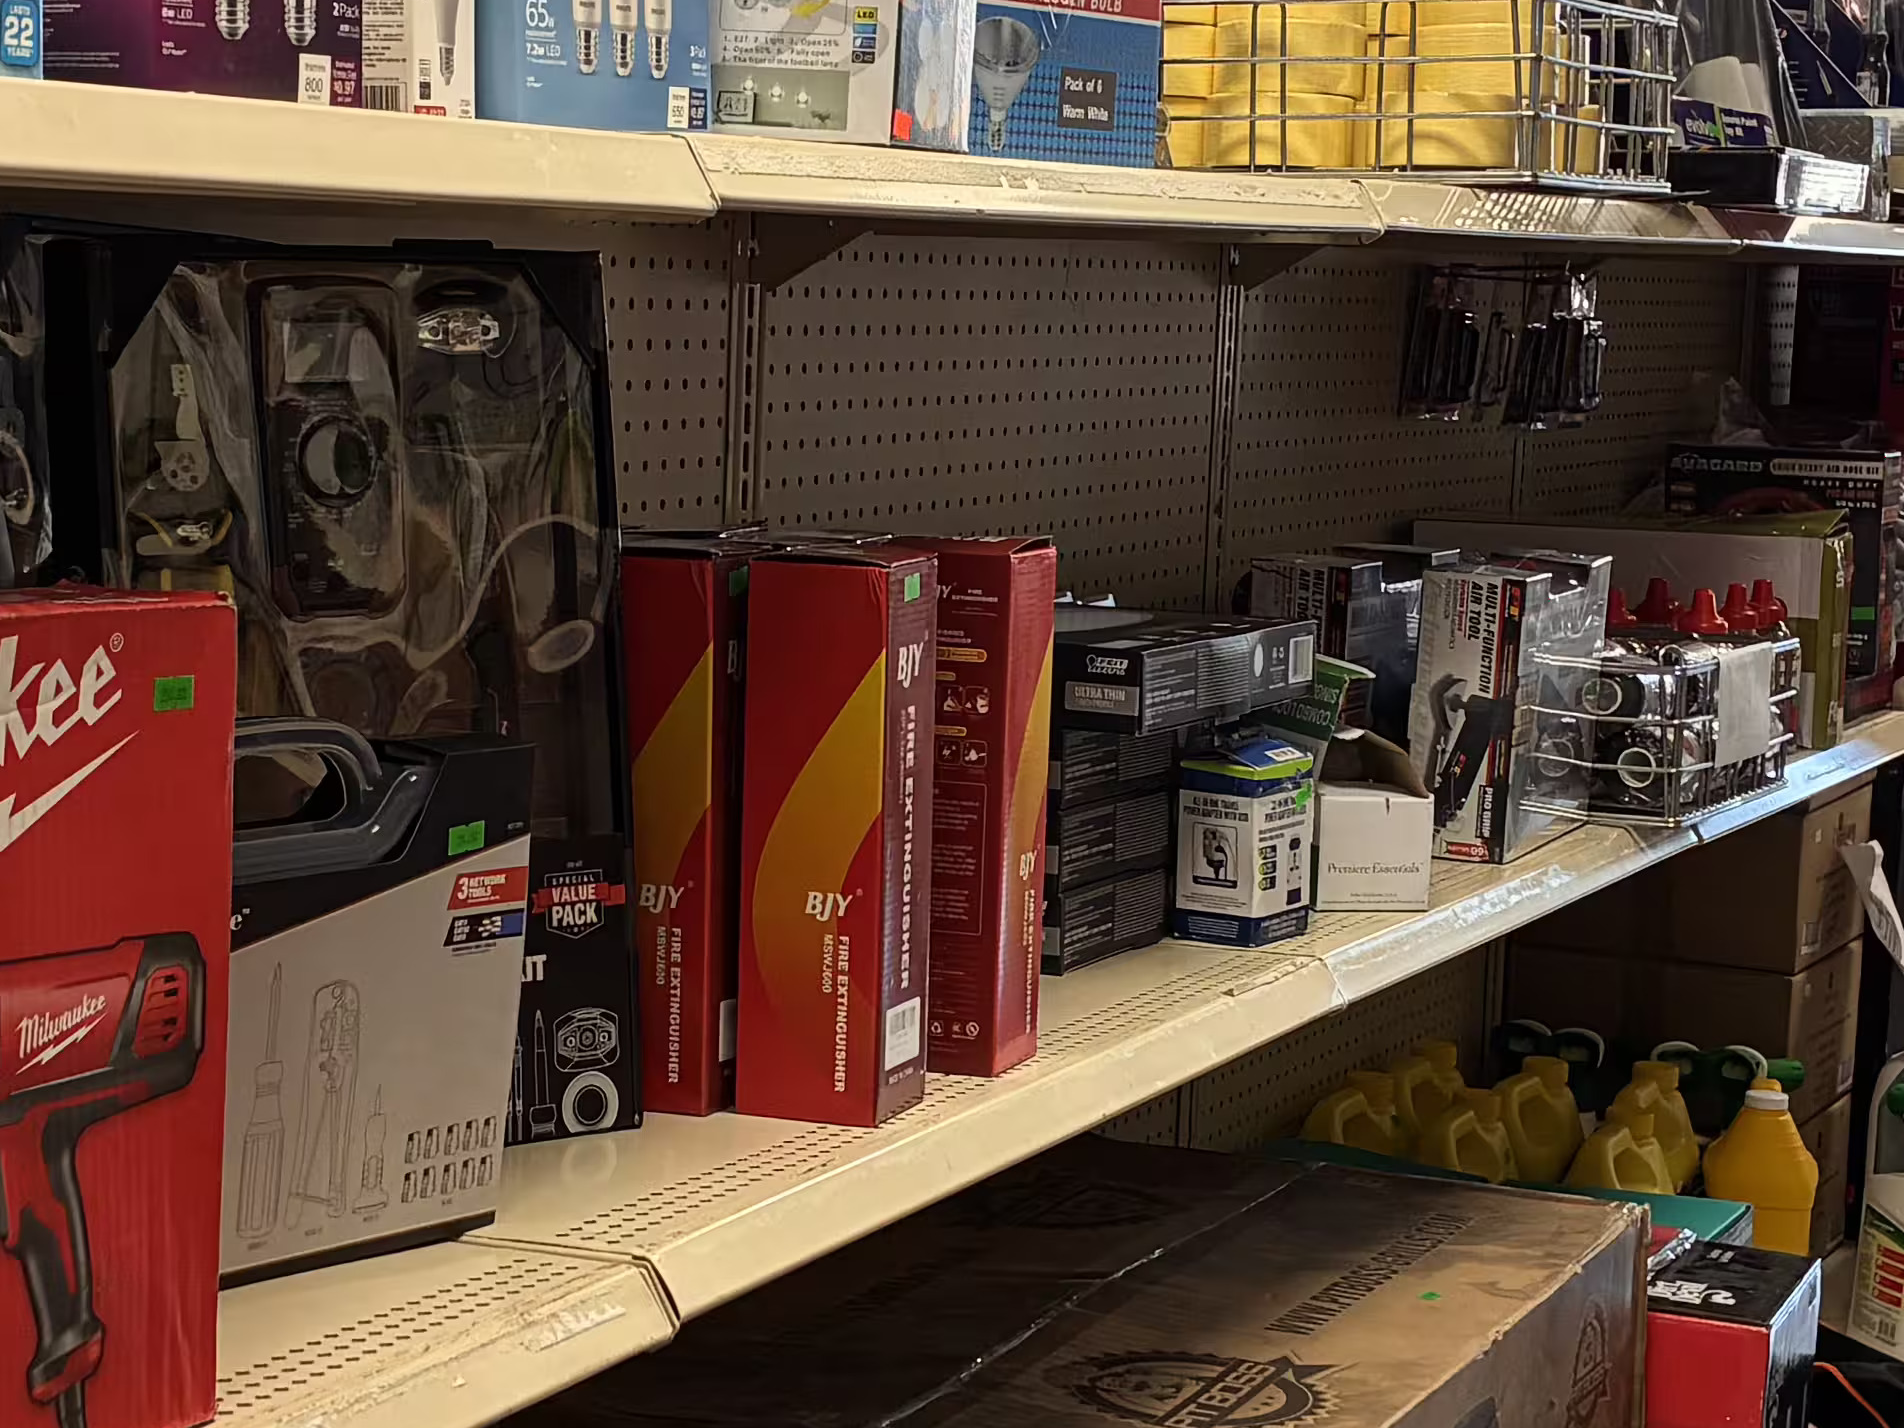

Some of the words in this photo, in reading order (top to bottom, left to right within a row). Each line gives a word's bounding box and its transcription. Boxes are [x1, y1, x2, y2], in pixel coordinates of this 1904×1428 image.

[176, 8, 194, 19] LED
[856, 9, 875, 21] LED
[2, 16, 34, 49] 22
[304, 76, 324, 94] 800
[1063, 76, 1084, 92] Pack
[1084, 79, 1095, 93] of
[1062, 104, 1085, 120] Warm
[1086, 105, 1110, 123] White
[1298, 568, 1310, 592] AIR
[1470, 580, 1485, 600] AIR
[1467, 601, 1482, 641] TOOL
[1478, 584, 1499, 695] MULTI-FUNCTION
[896, 640, 925, 689] BJY
[1073, 685, 1096, 699] ULTRA
[1096, 688, 1126, 702] THIN
[904, 703, 917, 770] FIRE
[1483, 786, 1494, 805] PRO
[545, 874, 596, 884] SPECIAL
[1018, 850, 1037, 881] BJY
[1327, 861, 1371, 876] Premiere
[1371, 861, 1421, 876] Essentials
[456, 877, 470, 901] 3
[467, 885, 494, 899] TOOLS
[551, 883, 598, 903] VALUE
[638, 882, 686, 914] BJY
[898, 776, 916, 991] EXTINGUISHER
[550, 901, 599, 928] PACK
[804, 890, 854, 922] BJY
[669, 926, 682, 962] FIRE
[837, 935, 851, 971] FIRE
[15, 993, 107, 1060] Milwaukee
[667, 962, 683, 1085] EXTINGUISHER
[832, 970, 850, 1093] EXTINGUISHER
[1203, 1361, 1277, 1408] BOSS
